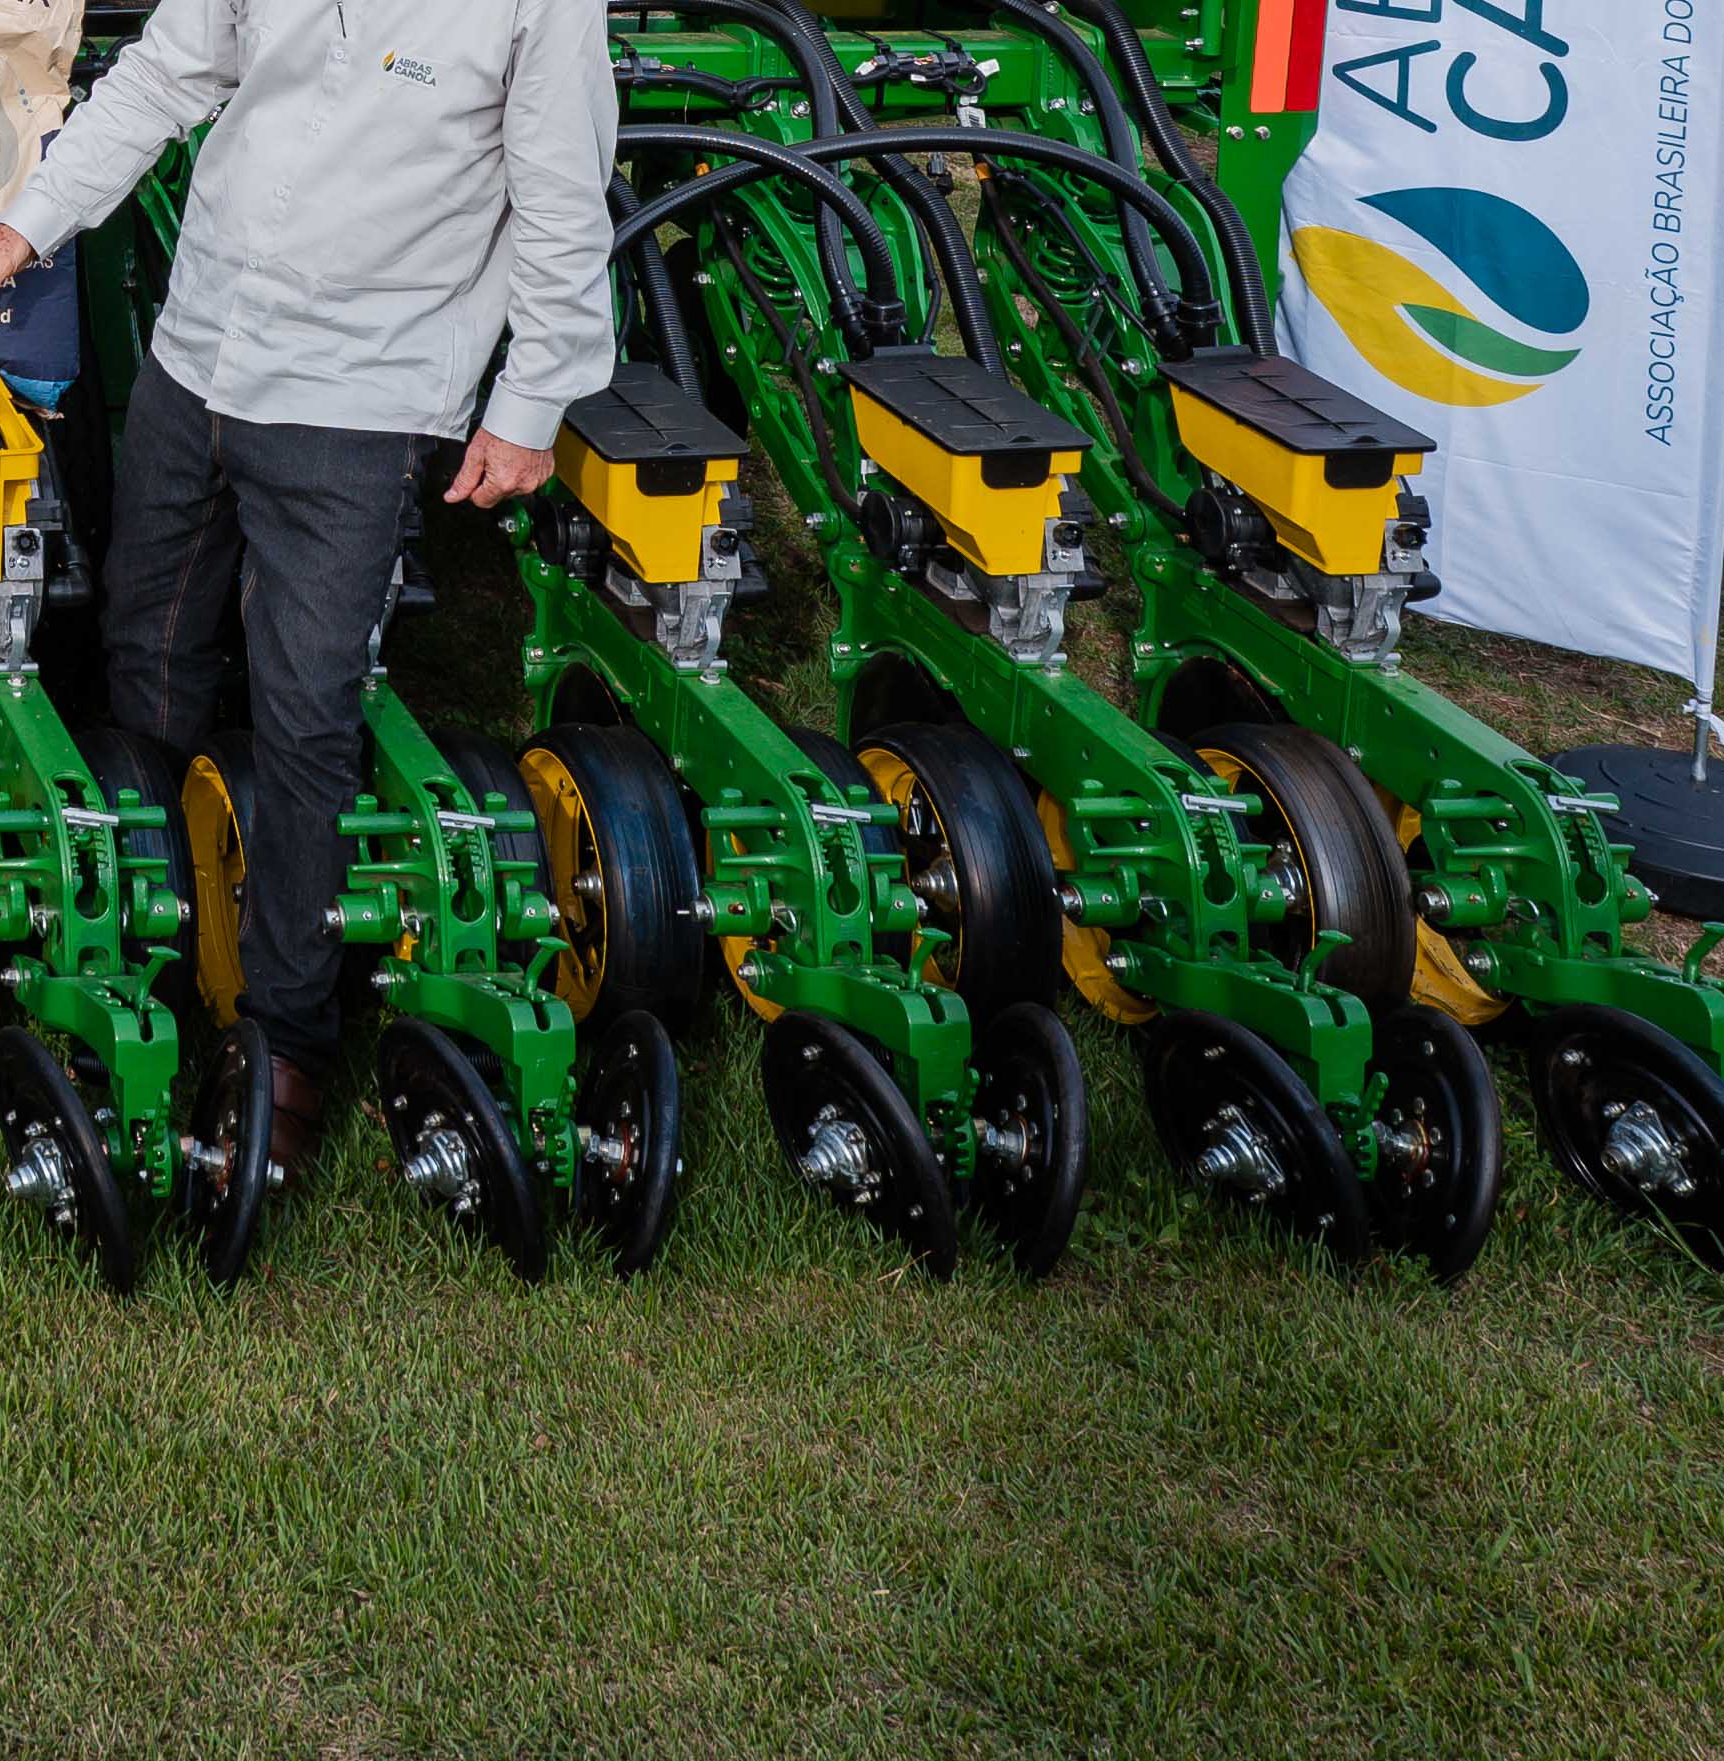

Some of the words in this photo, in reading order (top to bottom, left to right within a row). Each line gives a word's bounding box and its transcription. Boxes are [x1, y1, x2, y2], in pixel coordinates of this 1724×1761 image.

[394, 66, 436, 87] CANOLA
[396, 57, 433, 75] ABRAS
[1653, 54, 1691, 234] BRASILEIRA
[1645, 241, 1687, 447] ASSOCIAÇÃO
